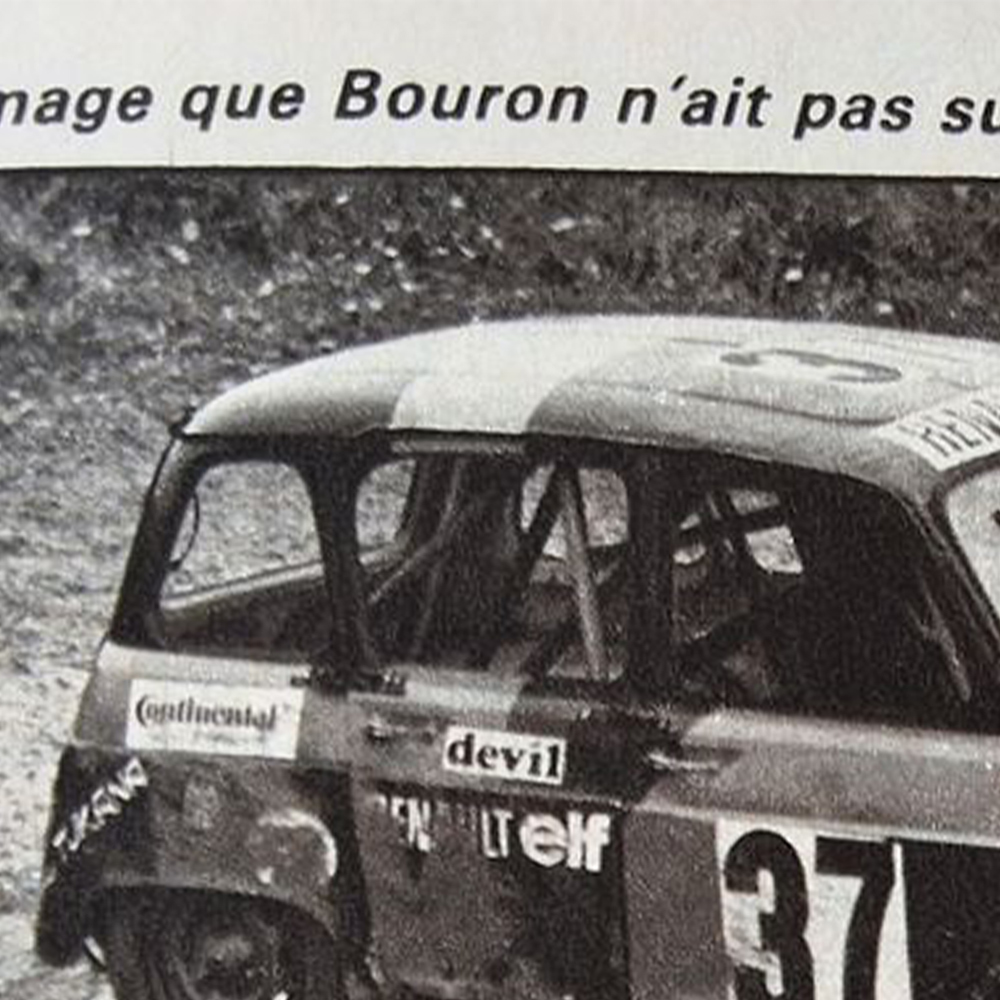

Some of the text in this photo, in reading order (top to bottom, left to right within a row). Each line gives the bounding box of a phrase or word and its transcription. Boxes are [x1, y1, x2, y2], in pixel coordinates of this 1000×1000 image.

[180, 82, 306, 132] que
[334, 68, 589, 123] Bouron
[792, 92, 915, 141] pas
[447, 733, 560, 778] devil
[517, 810, 612, 873] elf
